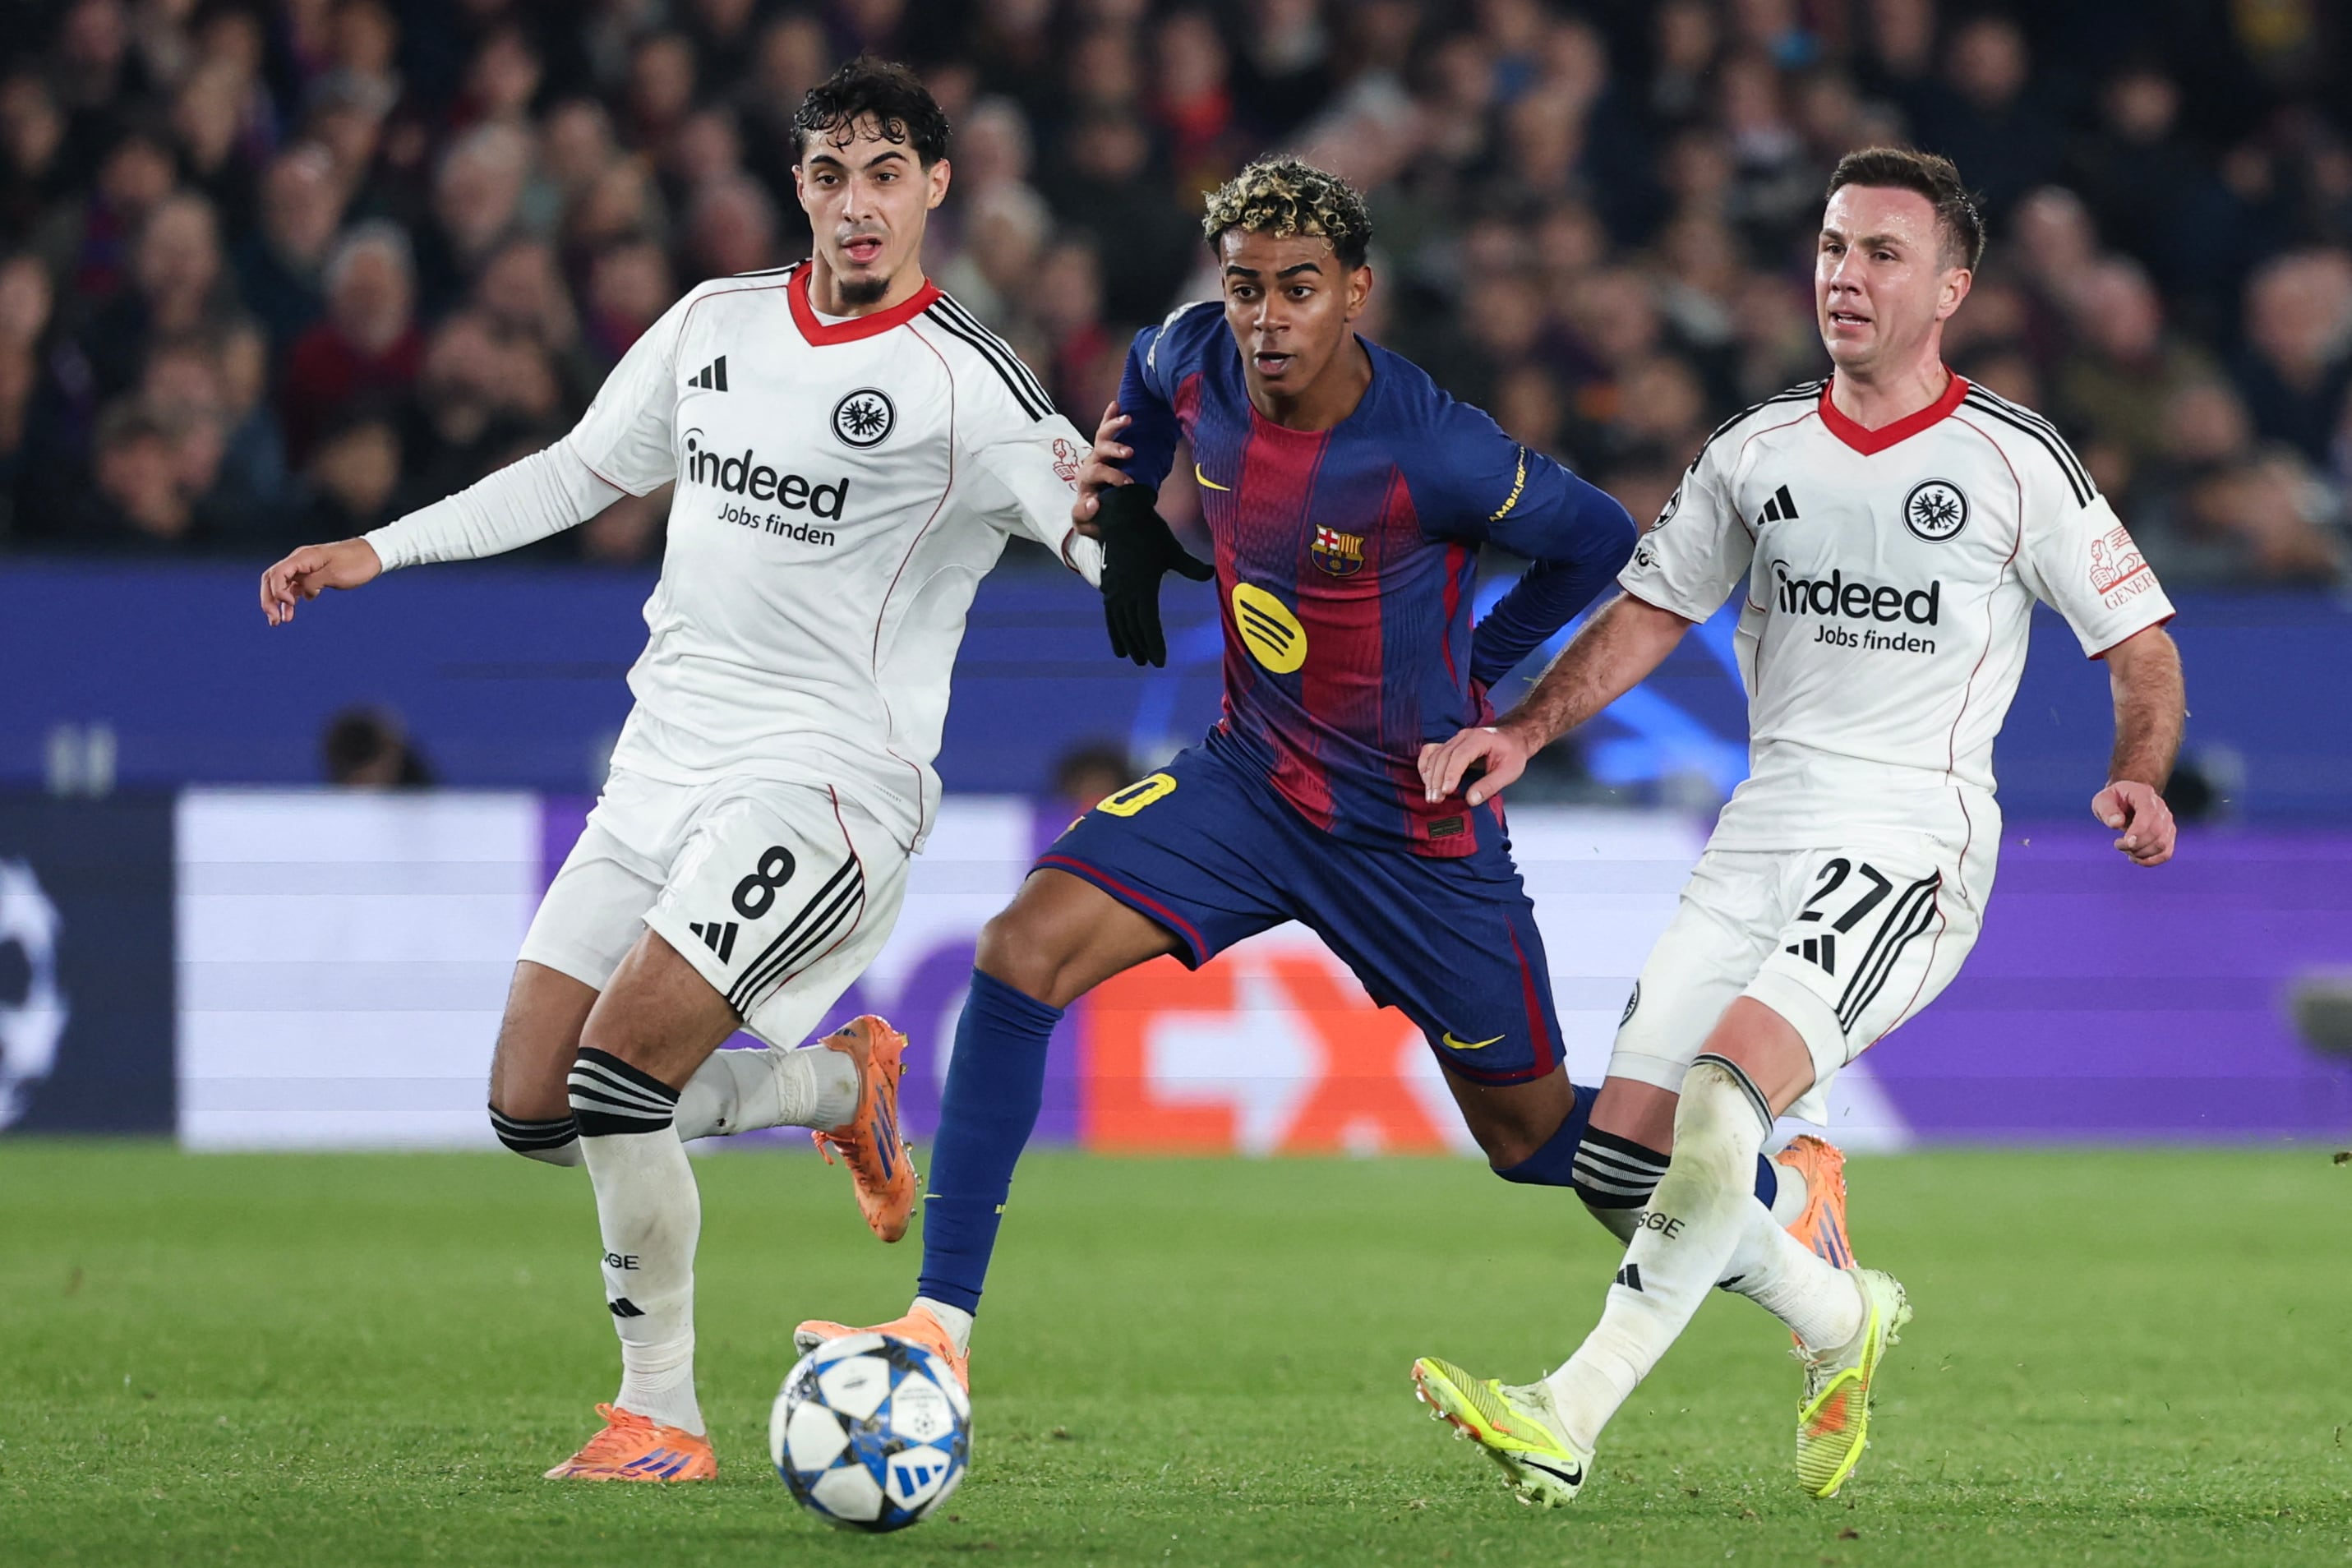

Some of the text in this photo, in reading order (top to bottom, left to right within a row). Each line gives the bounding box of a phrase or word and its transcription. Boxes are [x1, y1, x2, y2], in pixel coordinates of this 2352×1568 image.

[685, 436, 850, 522] indeed
[717, 502, 836, 546] Jobs finden
[1776, 568, 1940, 626] indeed
[1814, 625, 1936, 655] Jobs finden
[731, 845, 796, 920] 8
[1796, 857, 1893, 934] 27
